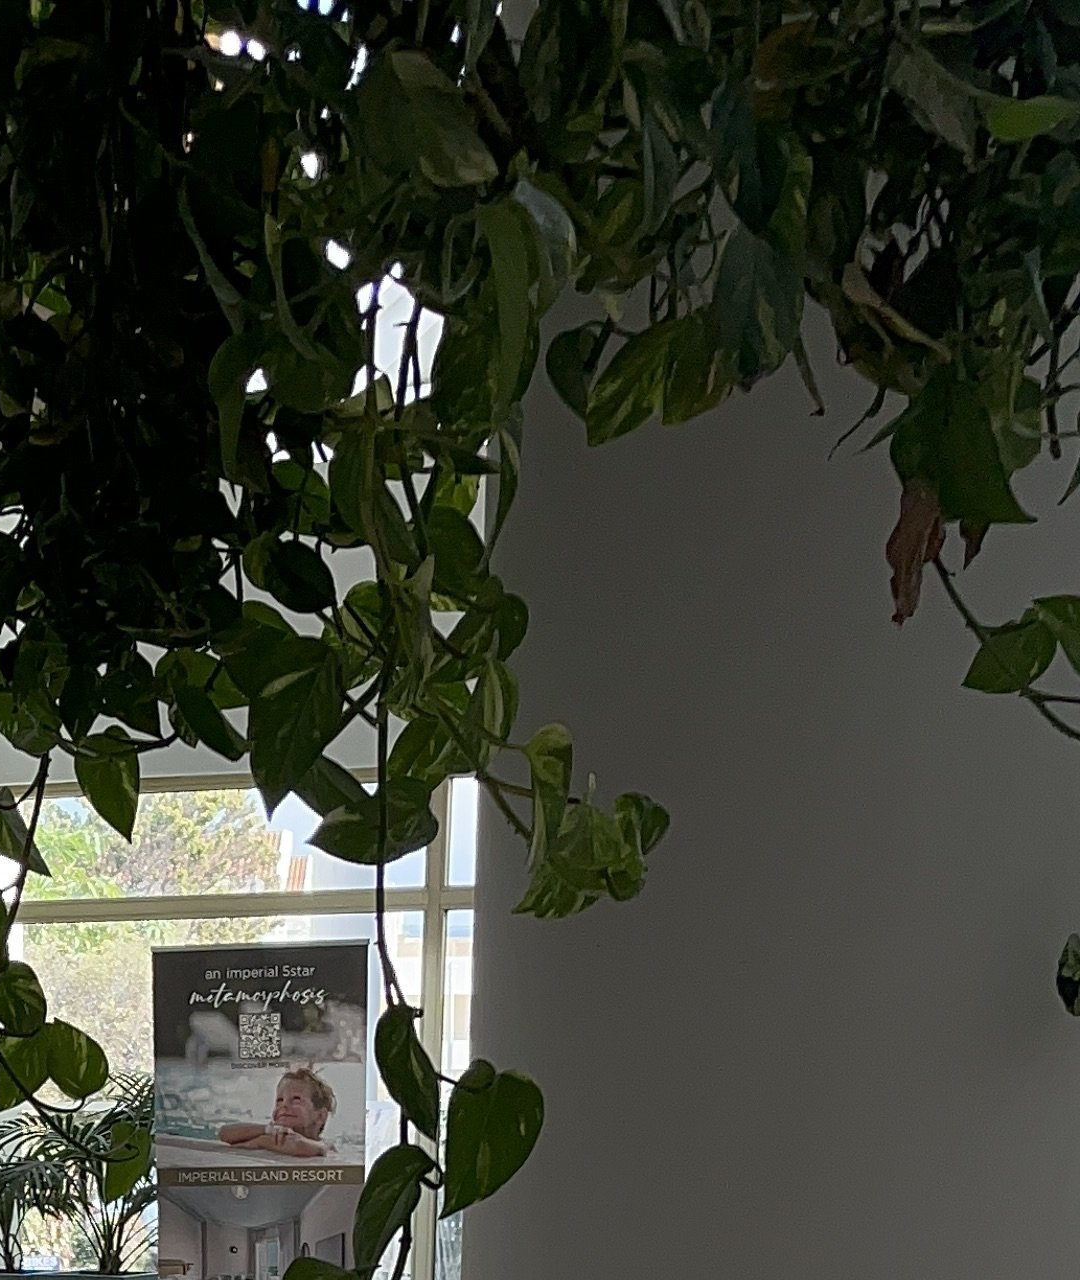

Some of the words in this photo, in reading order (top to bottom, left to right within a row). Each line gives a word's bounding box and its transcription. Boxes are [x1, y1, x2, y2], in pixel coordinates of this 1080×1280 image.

[205, 969, 221, 980] an
[226, 965, 279, 980] imperial
[282, 965, 316, 977] 5star
[189, 980, 328, 1012] metamorphosis
[178, 1171, 238, 1183] IMPERIAL
[241, 1170, 289, 1182] ISLAND
[292, 1169, 345, 1181] RESORT
